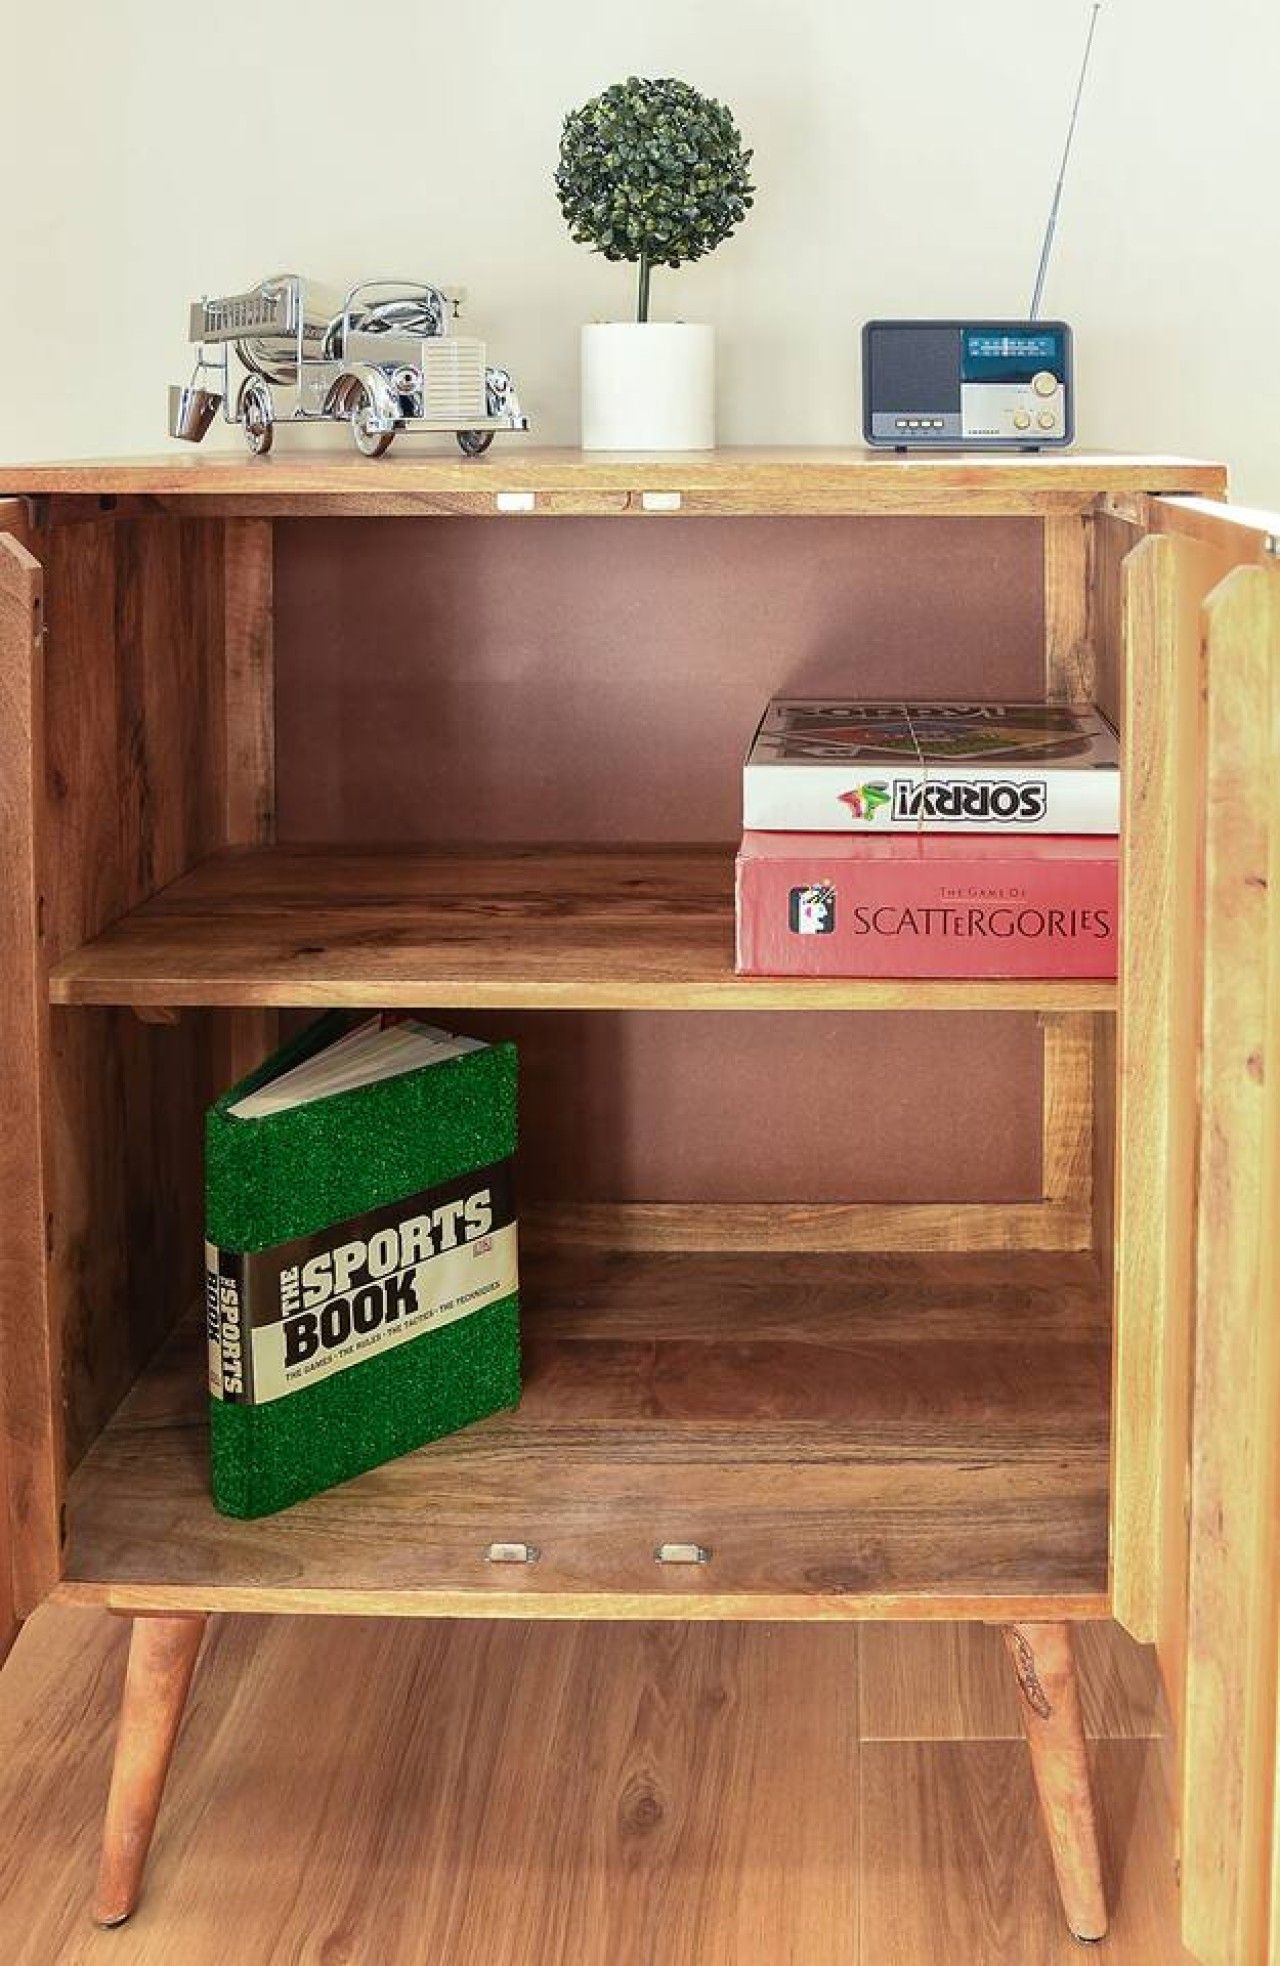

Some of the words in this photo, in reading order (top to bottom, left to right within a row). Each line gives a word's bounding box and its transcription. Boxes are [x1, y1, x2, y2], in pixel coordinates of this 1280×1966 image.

[897, 784, 1043, 818] SORRY!
[853, 905, 1110, 939] SCATTERGORIES
[940, 886, 962, 897] THE
[968, 886, 1004, 898] GAME
[280, 1265, 299, 1317] THE
[302, 1189, 493, 1308] SPORTS
[220, 1288, 243, 1394] SPORTS
[283, 1268, 419, 1368] BOOK
